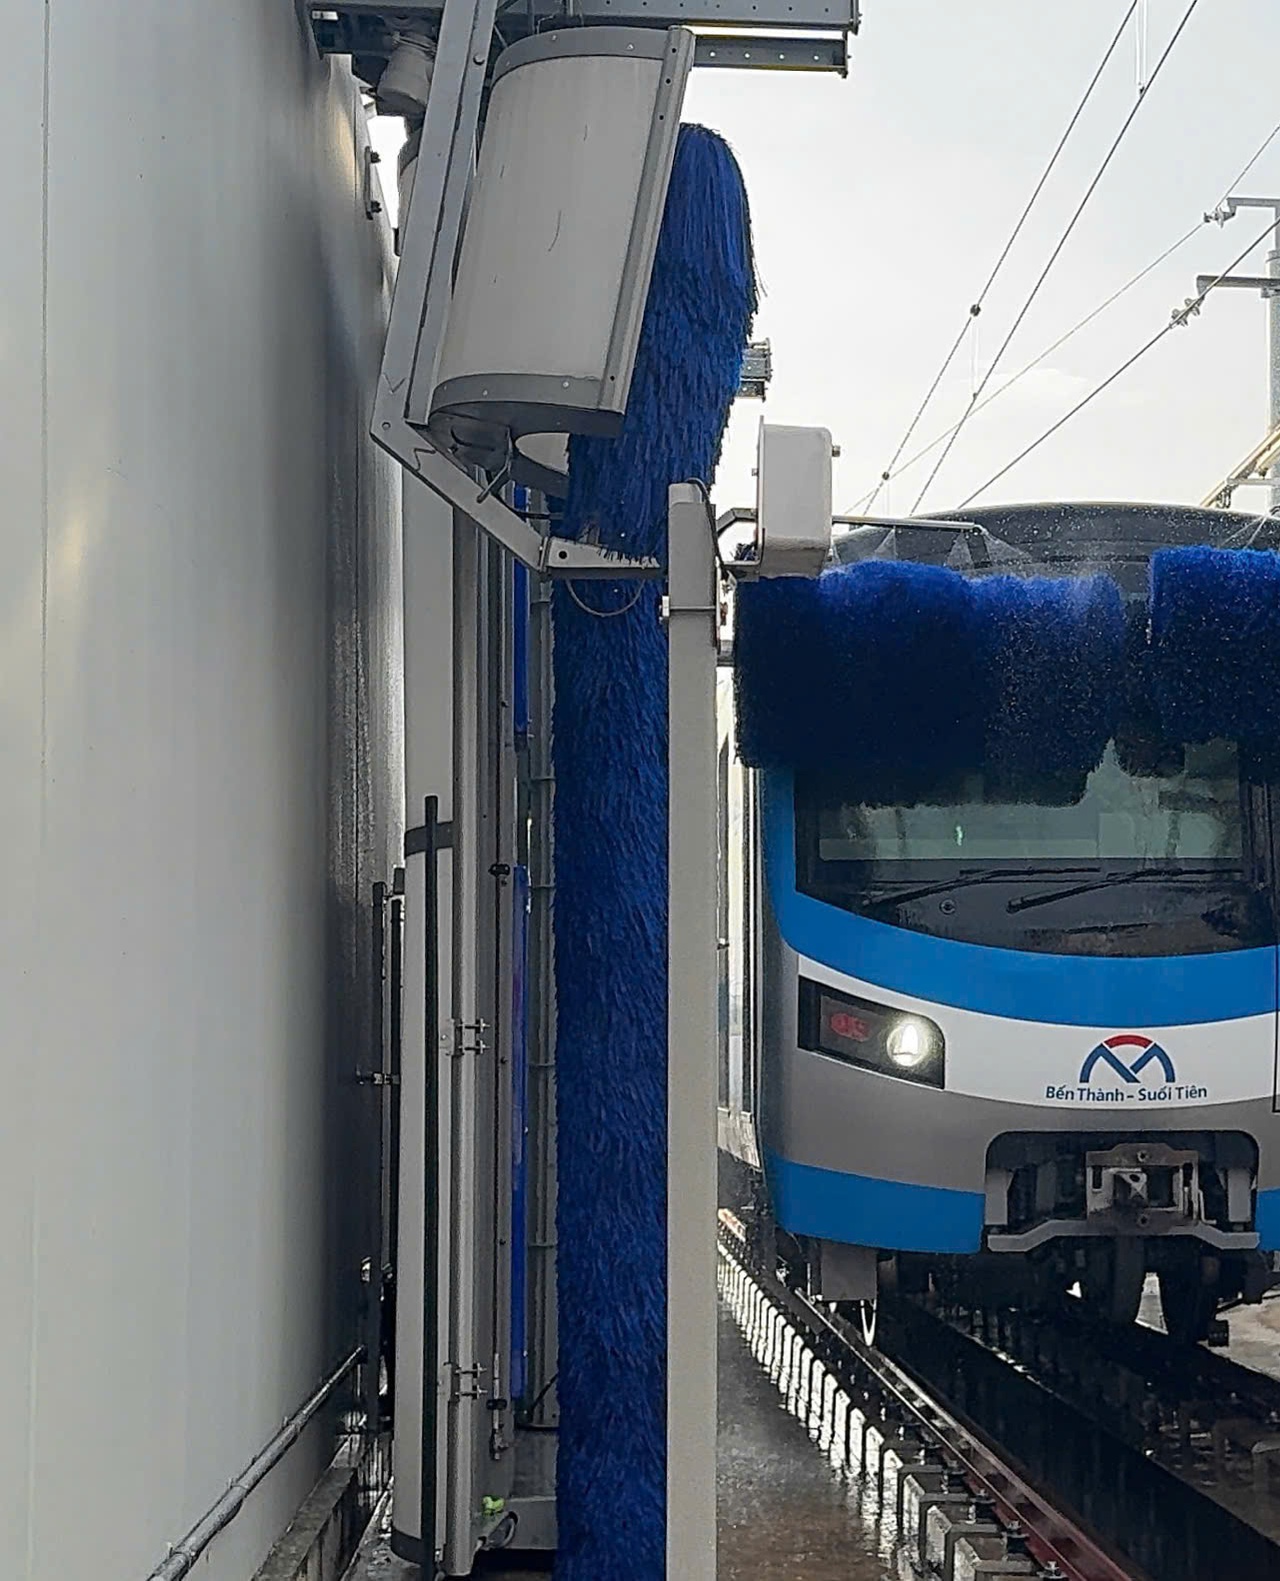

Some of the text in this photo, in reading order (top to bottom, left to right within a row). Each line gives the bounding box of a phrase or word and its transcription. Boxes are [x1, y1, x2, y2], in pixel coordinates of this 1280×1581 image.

[1046, 1084, 1075, 1100] Bến
[1138, 1086, 1172, 1101] Suối
[1174, 1085, 1208, 1100] Tiên
